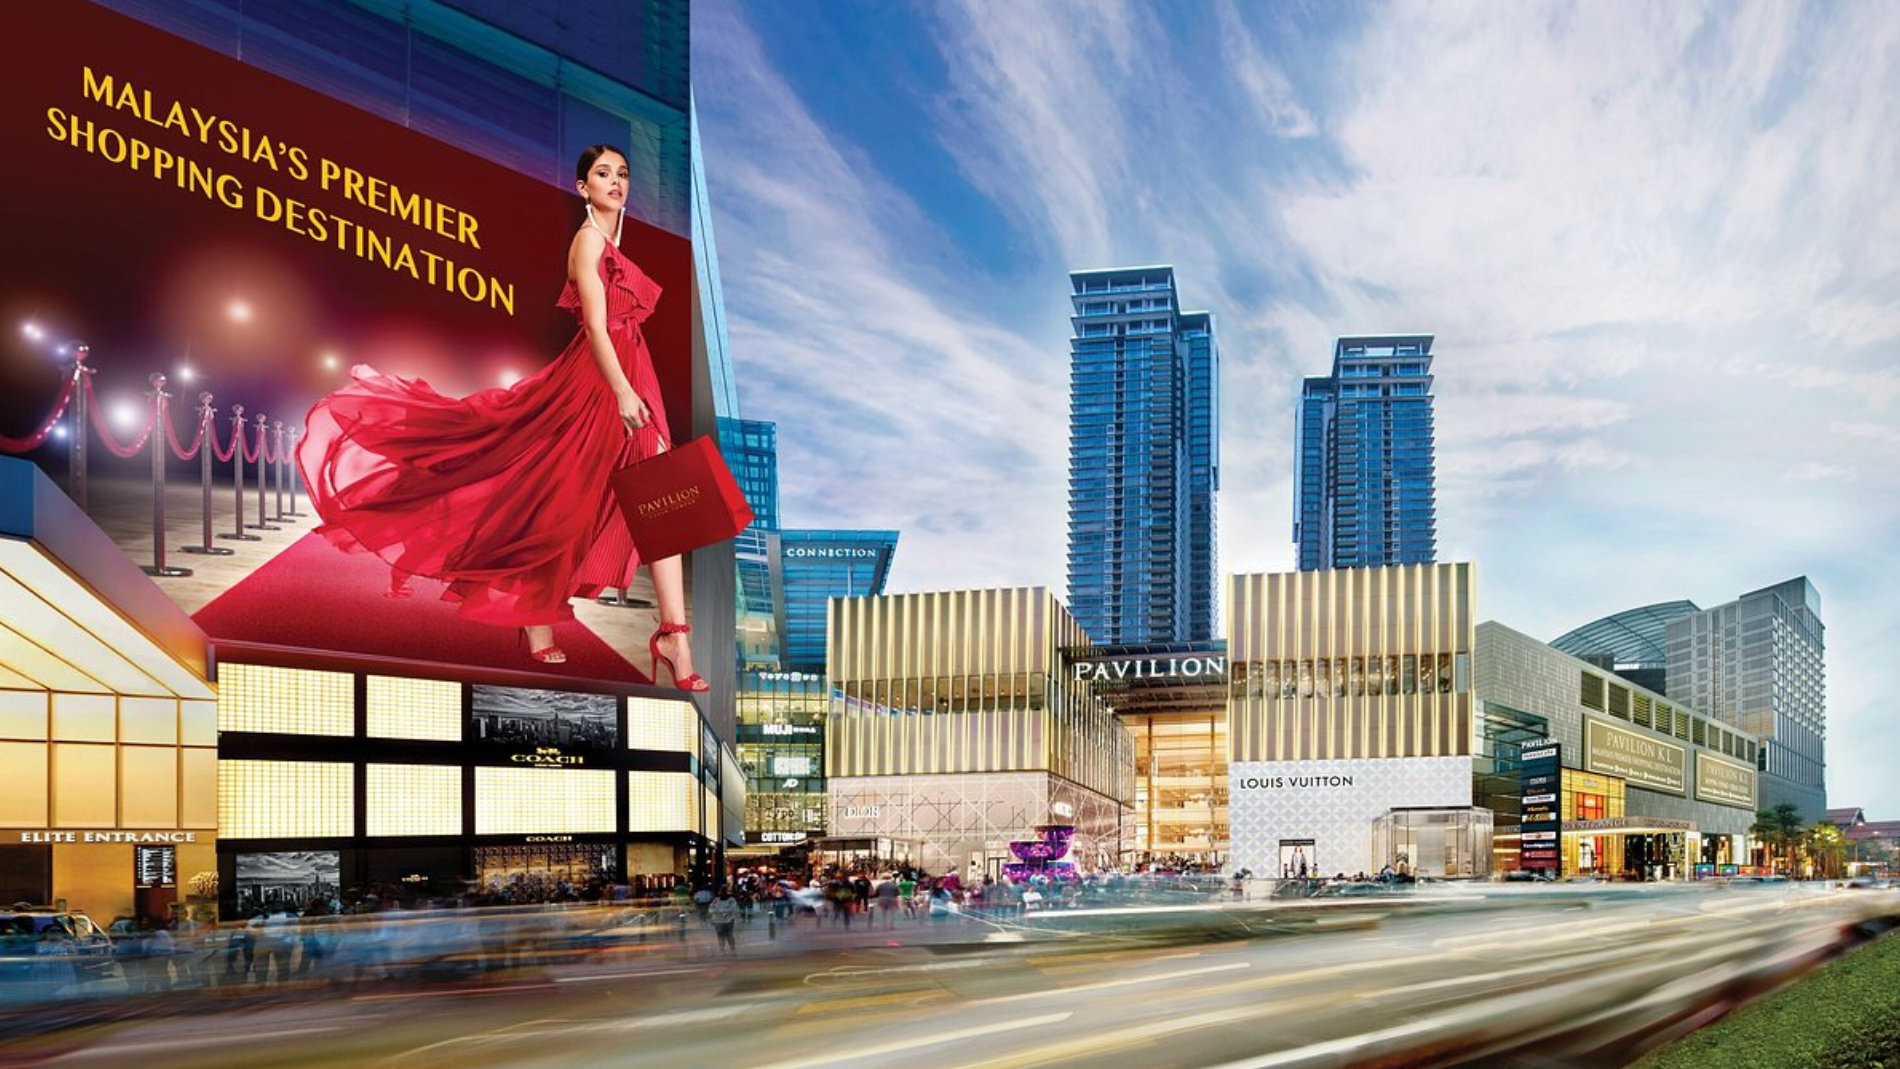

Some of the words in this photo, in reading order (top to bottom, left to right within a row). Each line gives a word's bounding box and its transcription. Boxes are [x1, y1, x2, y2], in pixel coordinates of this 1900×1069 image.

[322, 158, 482, 250] PREMIER
[48, 107, 243, 209] SHOPPING
[257, 187, 515, 316] DESTINATION
[637, 485, 700, 516] PAVILION
[786, 547, 877, 558] CONNECTION
[1074, 656, 1226, 681] PAVILION
[763, 725, 793, 735] MUJI
[1521, 738, 1559, 749] PAVILION
[1606, 732, 1656, 758] PAVILION
[510, 754, 584, 764] COACH
[1240, 776, 1284, 789] LOUIS
[1288, 775, 1354, 788] VUITTON
[20, 832, 76, 843] ELITE
[84, 832, 196, 843] ENTRANCE
